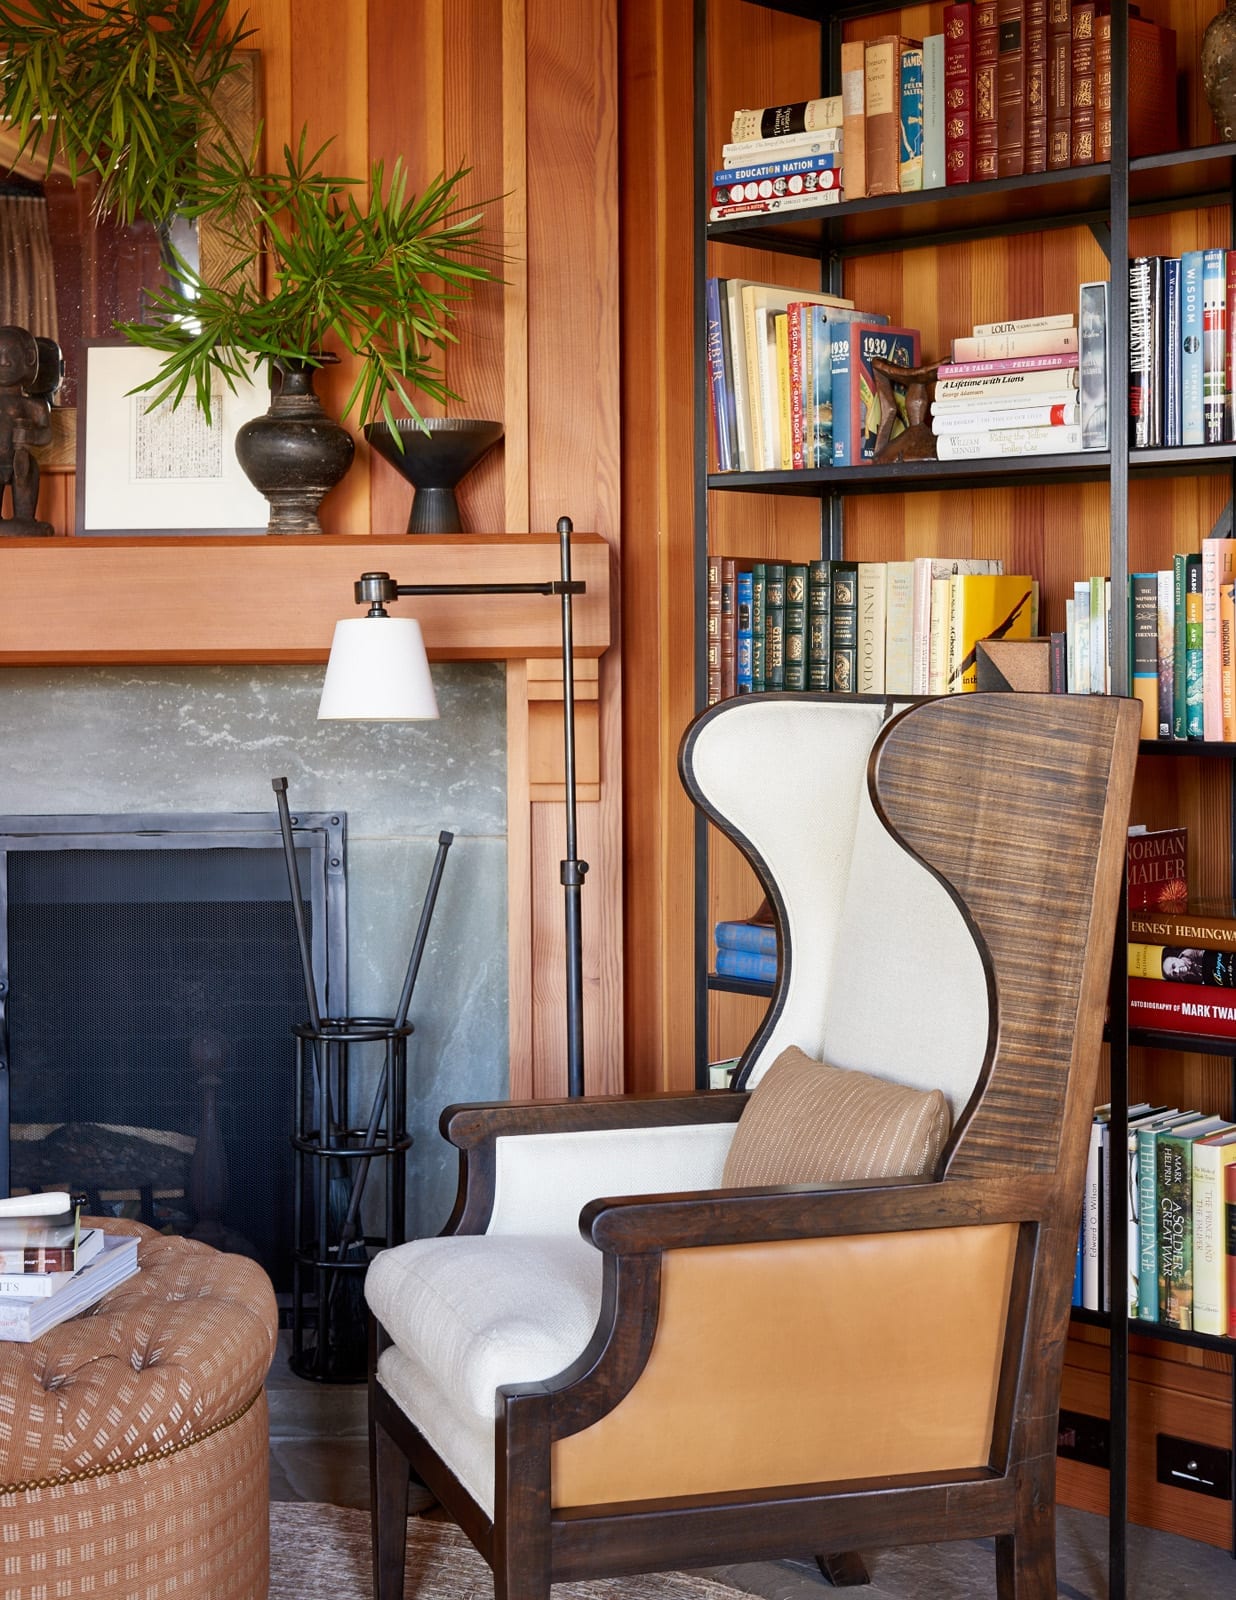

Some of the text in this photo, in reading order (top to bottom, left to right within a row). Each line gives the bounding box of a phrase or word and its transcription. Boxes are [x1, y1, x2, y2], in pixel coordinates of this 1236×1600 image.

[903, 55, 922, 68] BAMB
[774, 108, 783, 136] Triumph
[783, 107, 793, 134] Tragedy
[735, 160, 813, 179] EDUCATION NATION
[1186, 268, 1196, 324] WISDOM
[991, 323, 1016, 334] LOLITA
[709, 319, 722, 382] AMBER
[831, 341, 849, 355] 1939
[864, 337, 887, 354] 1939
[1037, 357, 1062, 366] BEARD
[949, 380, 982, 391] Lifetime
[982, 377, 1001, 386] with
[1001, 375, 1025, 384] Lions
[863, 586, 874, 625] JANE
[753, 583, 763, 678] BEFORE ADAM
[773, 626, 782, 667] GREEN
[863, 629, 874, 692] GOODA
[963, 675, 970, 685] in
[1222, 619, 1231, 718] INDIGNATION PHILIP ROTH
[1127, 836, 1186, 860] NORMAN
[1127, 859, 1186, 886] MAILER
[1131, 921, 1236, 942] ERNEST HEMINGWA
[1130, 1000, 1172, 1011] AUTOBIOGRAPHY
[1173, 1004, 1181, 1012] OF
[1181, 1002, 1211, 1018] MARK
[1164, 1147, 1172, 1186] HELPRIN
[1174, 1155, 1182, 1183] MARK
[1089, 1183, 1097, 1258] Edward O. Wilson
[1140, 1141, 1155, 1274] THE CHALLENGE
[1161, 1198, 1173, 1277] GREAT WAR
[1172, 1201, 1184, 1270] A SOLDIER
[1205, 1190, 1213, 1263] THE PRINCE AND
